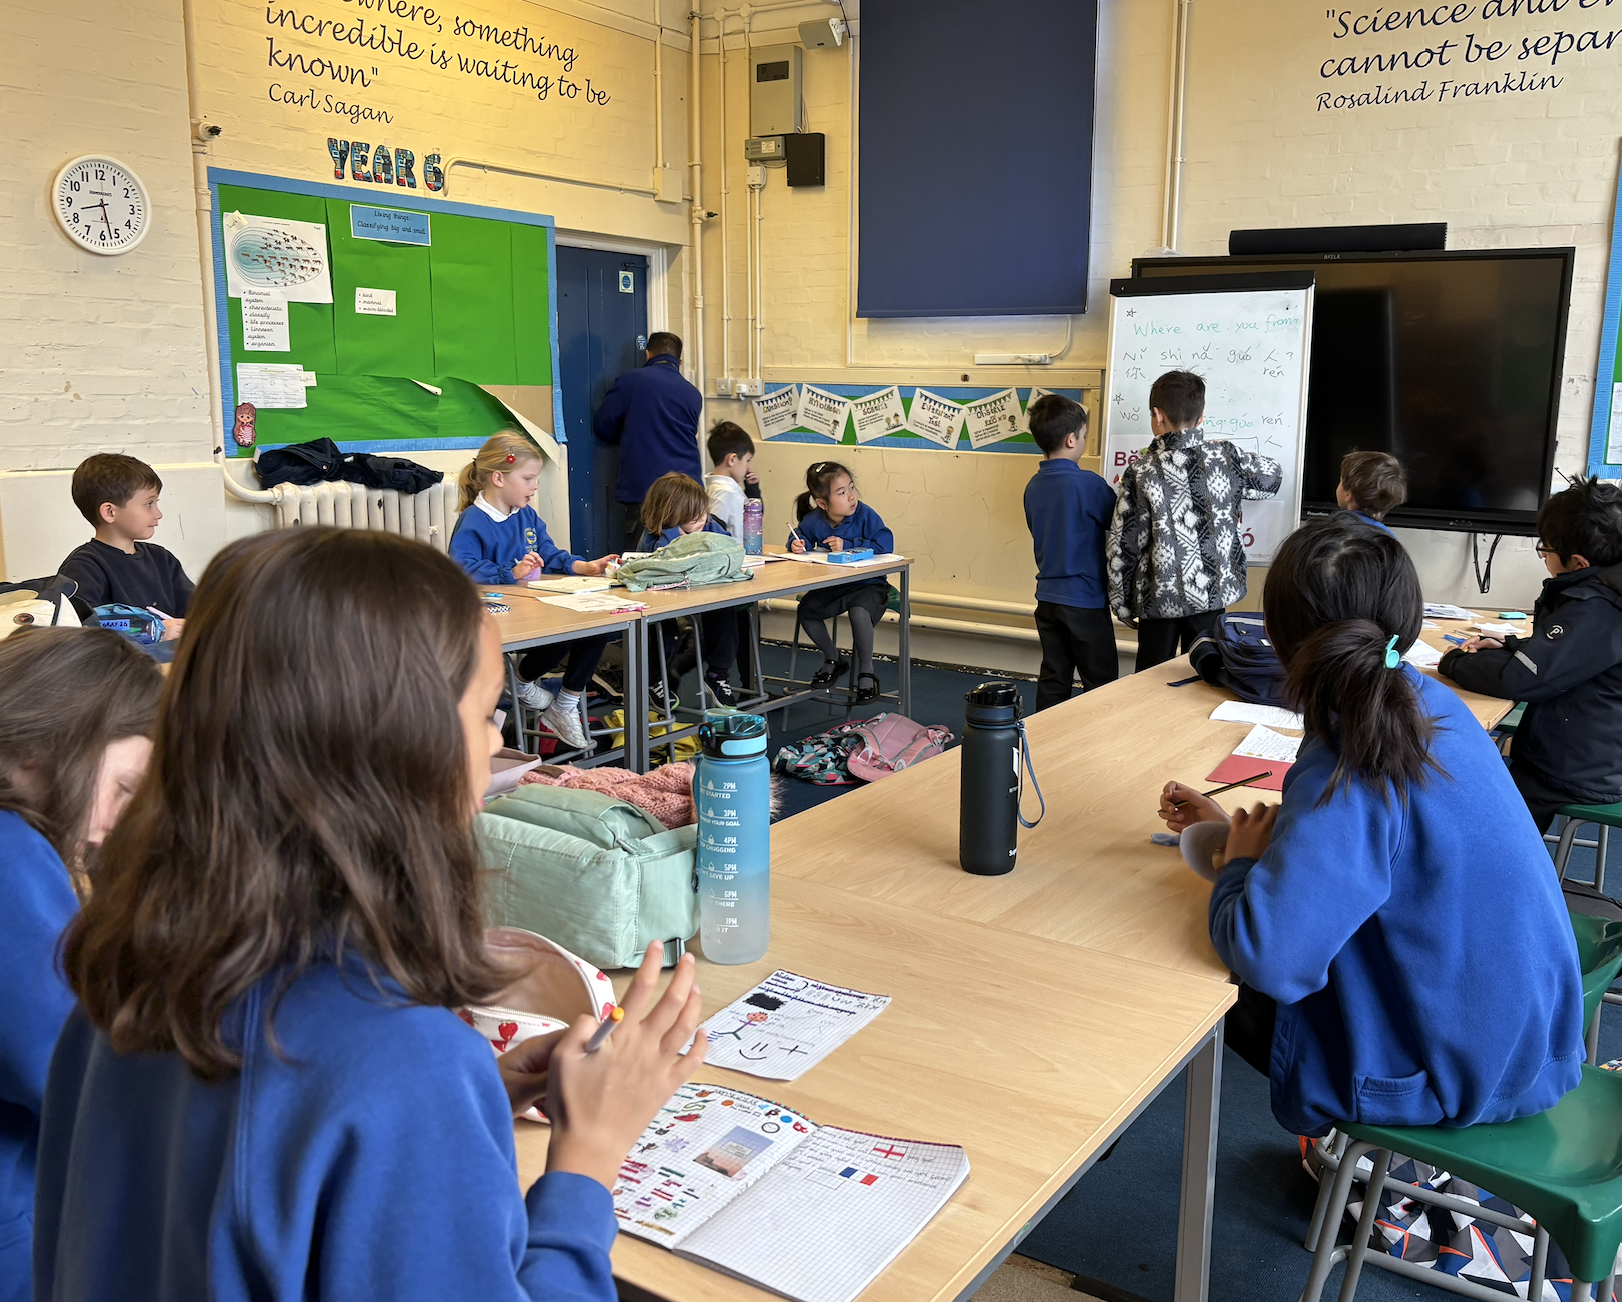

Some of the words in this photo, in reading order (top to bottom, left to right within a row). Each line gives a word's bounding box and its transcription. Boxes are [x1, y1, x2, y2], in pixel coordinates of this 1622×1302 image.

[1325, 1, 1477, 39] "Science
[453, 15, 580, 72] something
[266, 1, 425, 61] incredible
[430, 43, 453, 70] is
[457, 52, 555, 101] waiting
[557, 74, 583, 100] to
[585, 79, 613, 106] be
[1319, 39, 1459, 79] cannot
[1464, 33, 1513, 64] be
[266, 37, 380, 88] known"
[1315, 80, 1435, 112] Rosalind
[1438, 71, 1564, 103] Franklin
[268, 82, 322, 110] Carl
[323, 94, 395, 125] Sagan
[327, 137, 417, 189] YEAR
[423, 152, 446, 193] 6
[81, 170, 89, 183] 11
[95, 169, 106, 181] 12
[112, 175, 116, 187] 1
[70, 180, 81, 192] 10
[123, 187, 130, 199] 2
[66, 196, 73, 208] 9
[129, 204, 135, 215] 3
[72, 212, 80, 224] 8
[84, 224, 91, 236] 7
[124, 219, 132, 230] 4
[357, 220, 389, 232] Classifying
[391, 224, 400, 233] big
[99, 230, 106, 241] 6
[114, 228, 120, 239] 5
[1134, 320, 1183, 337] Where
[1196, 322, 1221, 333] are
[1234, 321, 1260, 334] you
[722, 782, 737, 790] 2PM
[705, 790, 731, 799] STARTED
[723, 809, 737, 817] 3PM
[723, 836, 737, 844] 4PM
[705, 844, 737, 854] CHUGGING
[723, 863, 737, 871] 5PM
[715, 900, 736, 908] THERE
[725, 917, 738, 925] 7PM
